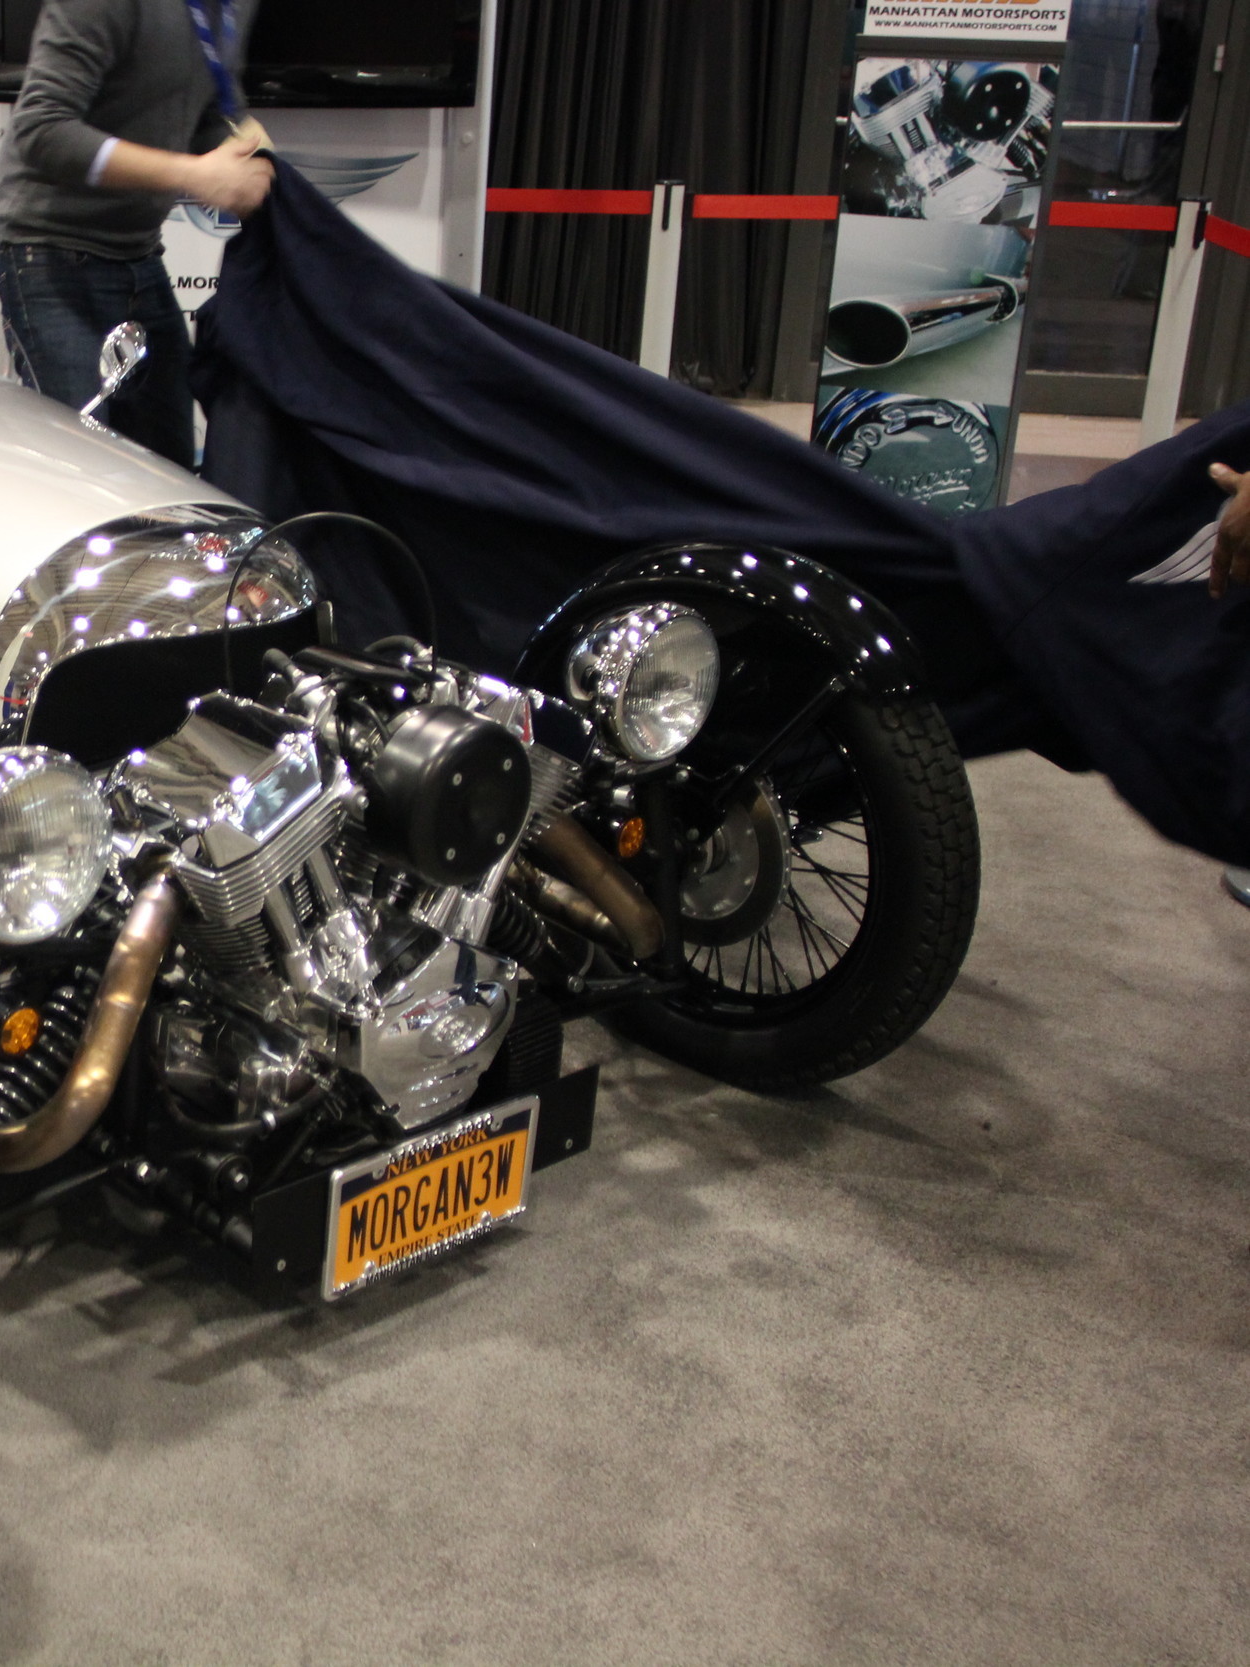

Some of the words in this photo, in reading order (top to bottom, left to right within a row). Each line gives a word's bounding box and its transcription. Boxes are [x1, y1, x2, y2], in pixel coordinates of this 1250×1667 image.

[869, 6, 958, 18] MANHATTAN
[961, 8, 1066, 20] MOTORSPORTS
[874, 20, 1057, 31] WWW.MANHATTANMOTORSPORTS.COM
[952, 412, 989, 464] UNDO
[387, 1147, 435, 1180] NEW
[441, 1129, 488, 1155] YORK
[347, 1138, 516, 1263] MORGAN3W
[378, 1233, 433, 1268] EMPIRE
[436, 1212, 479, 1240] STATE
